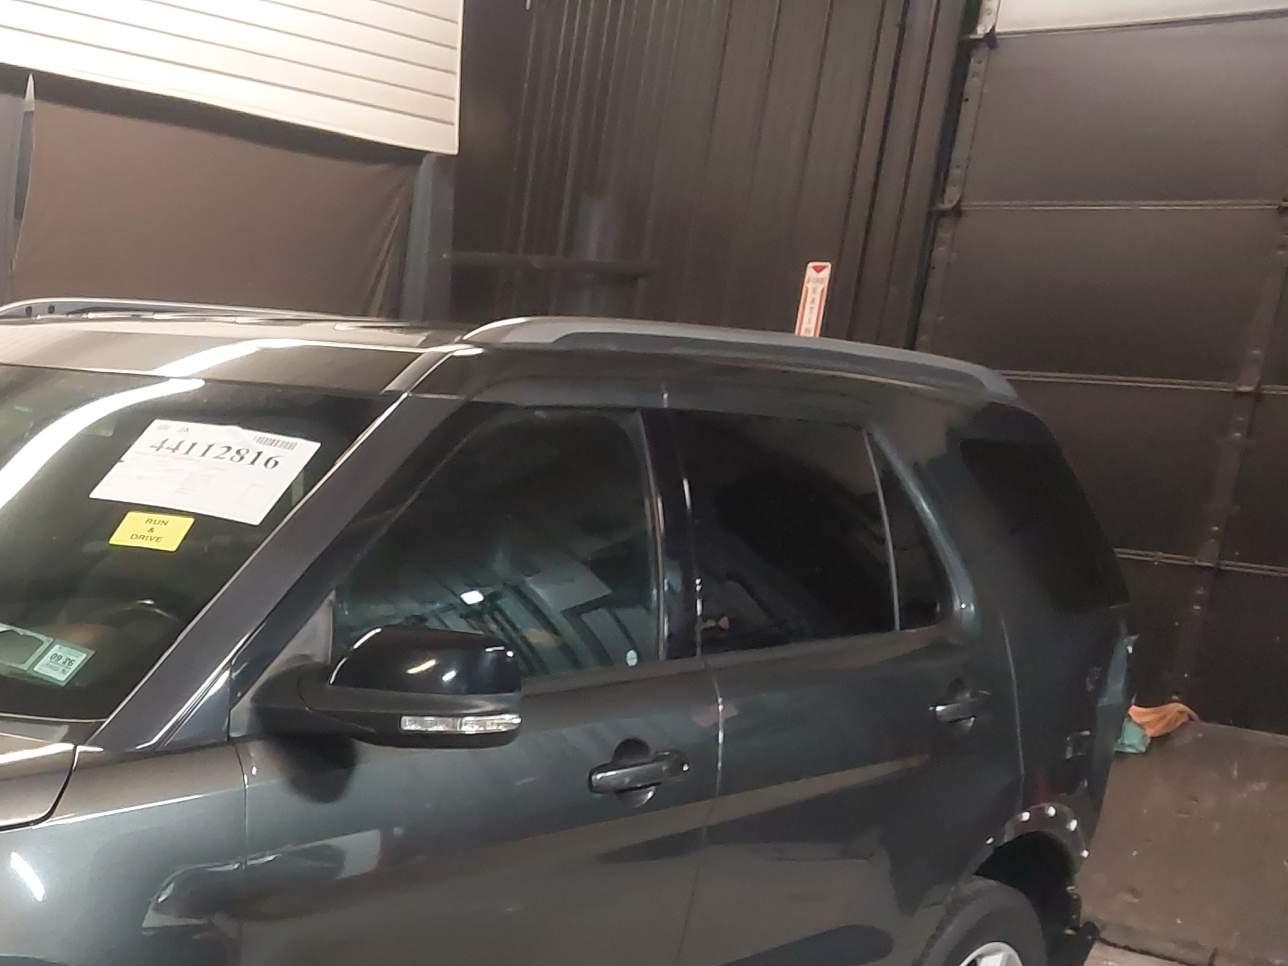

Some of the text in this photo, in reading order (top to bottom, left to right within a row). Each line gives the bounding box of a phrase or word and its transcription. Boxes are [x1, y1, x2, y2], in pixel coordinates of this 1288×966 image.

[149, 437, 281, 470] 44112816
[145, 518, 169, 526] RUN
[130, 533, 162, 543] DRIVE
